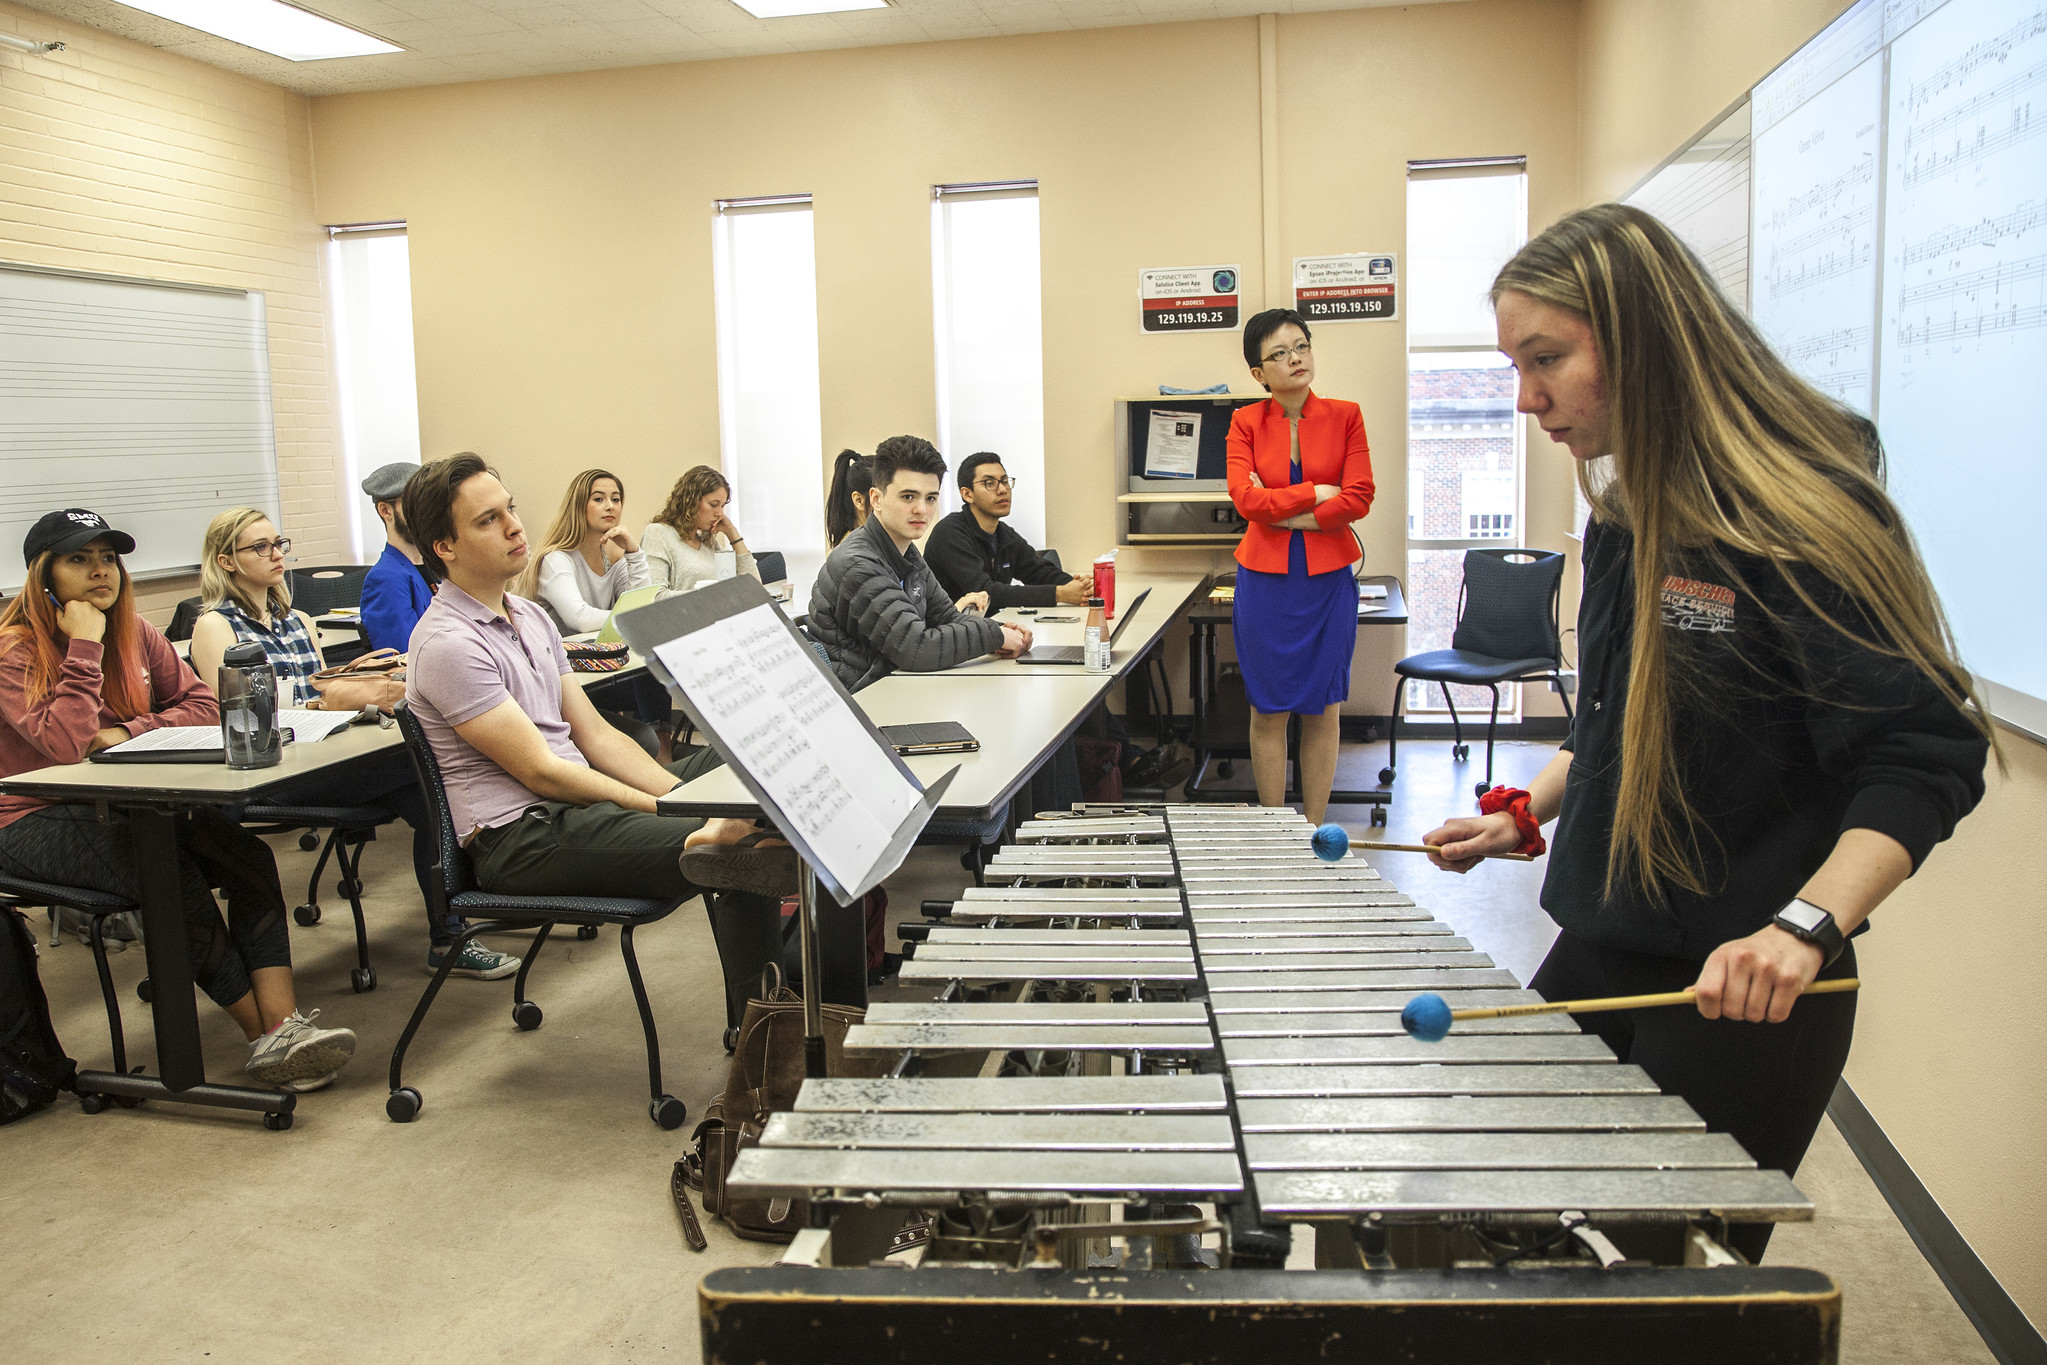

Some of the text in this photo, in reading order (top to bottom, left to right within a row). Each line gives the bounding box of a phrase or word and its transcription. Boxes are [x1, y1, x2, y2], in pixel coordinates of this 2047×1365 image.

[1326, 289, 1350, 297] ADDRESS
[1350, 288, 1362, 296] INTO
[1309, 300, 1382, 315] 129.119.19.150
[1158, 311, 1223, 325] 129.119.19.25
[66, 512, 100, 522] SMU
